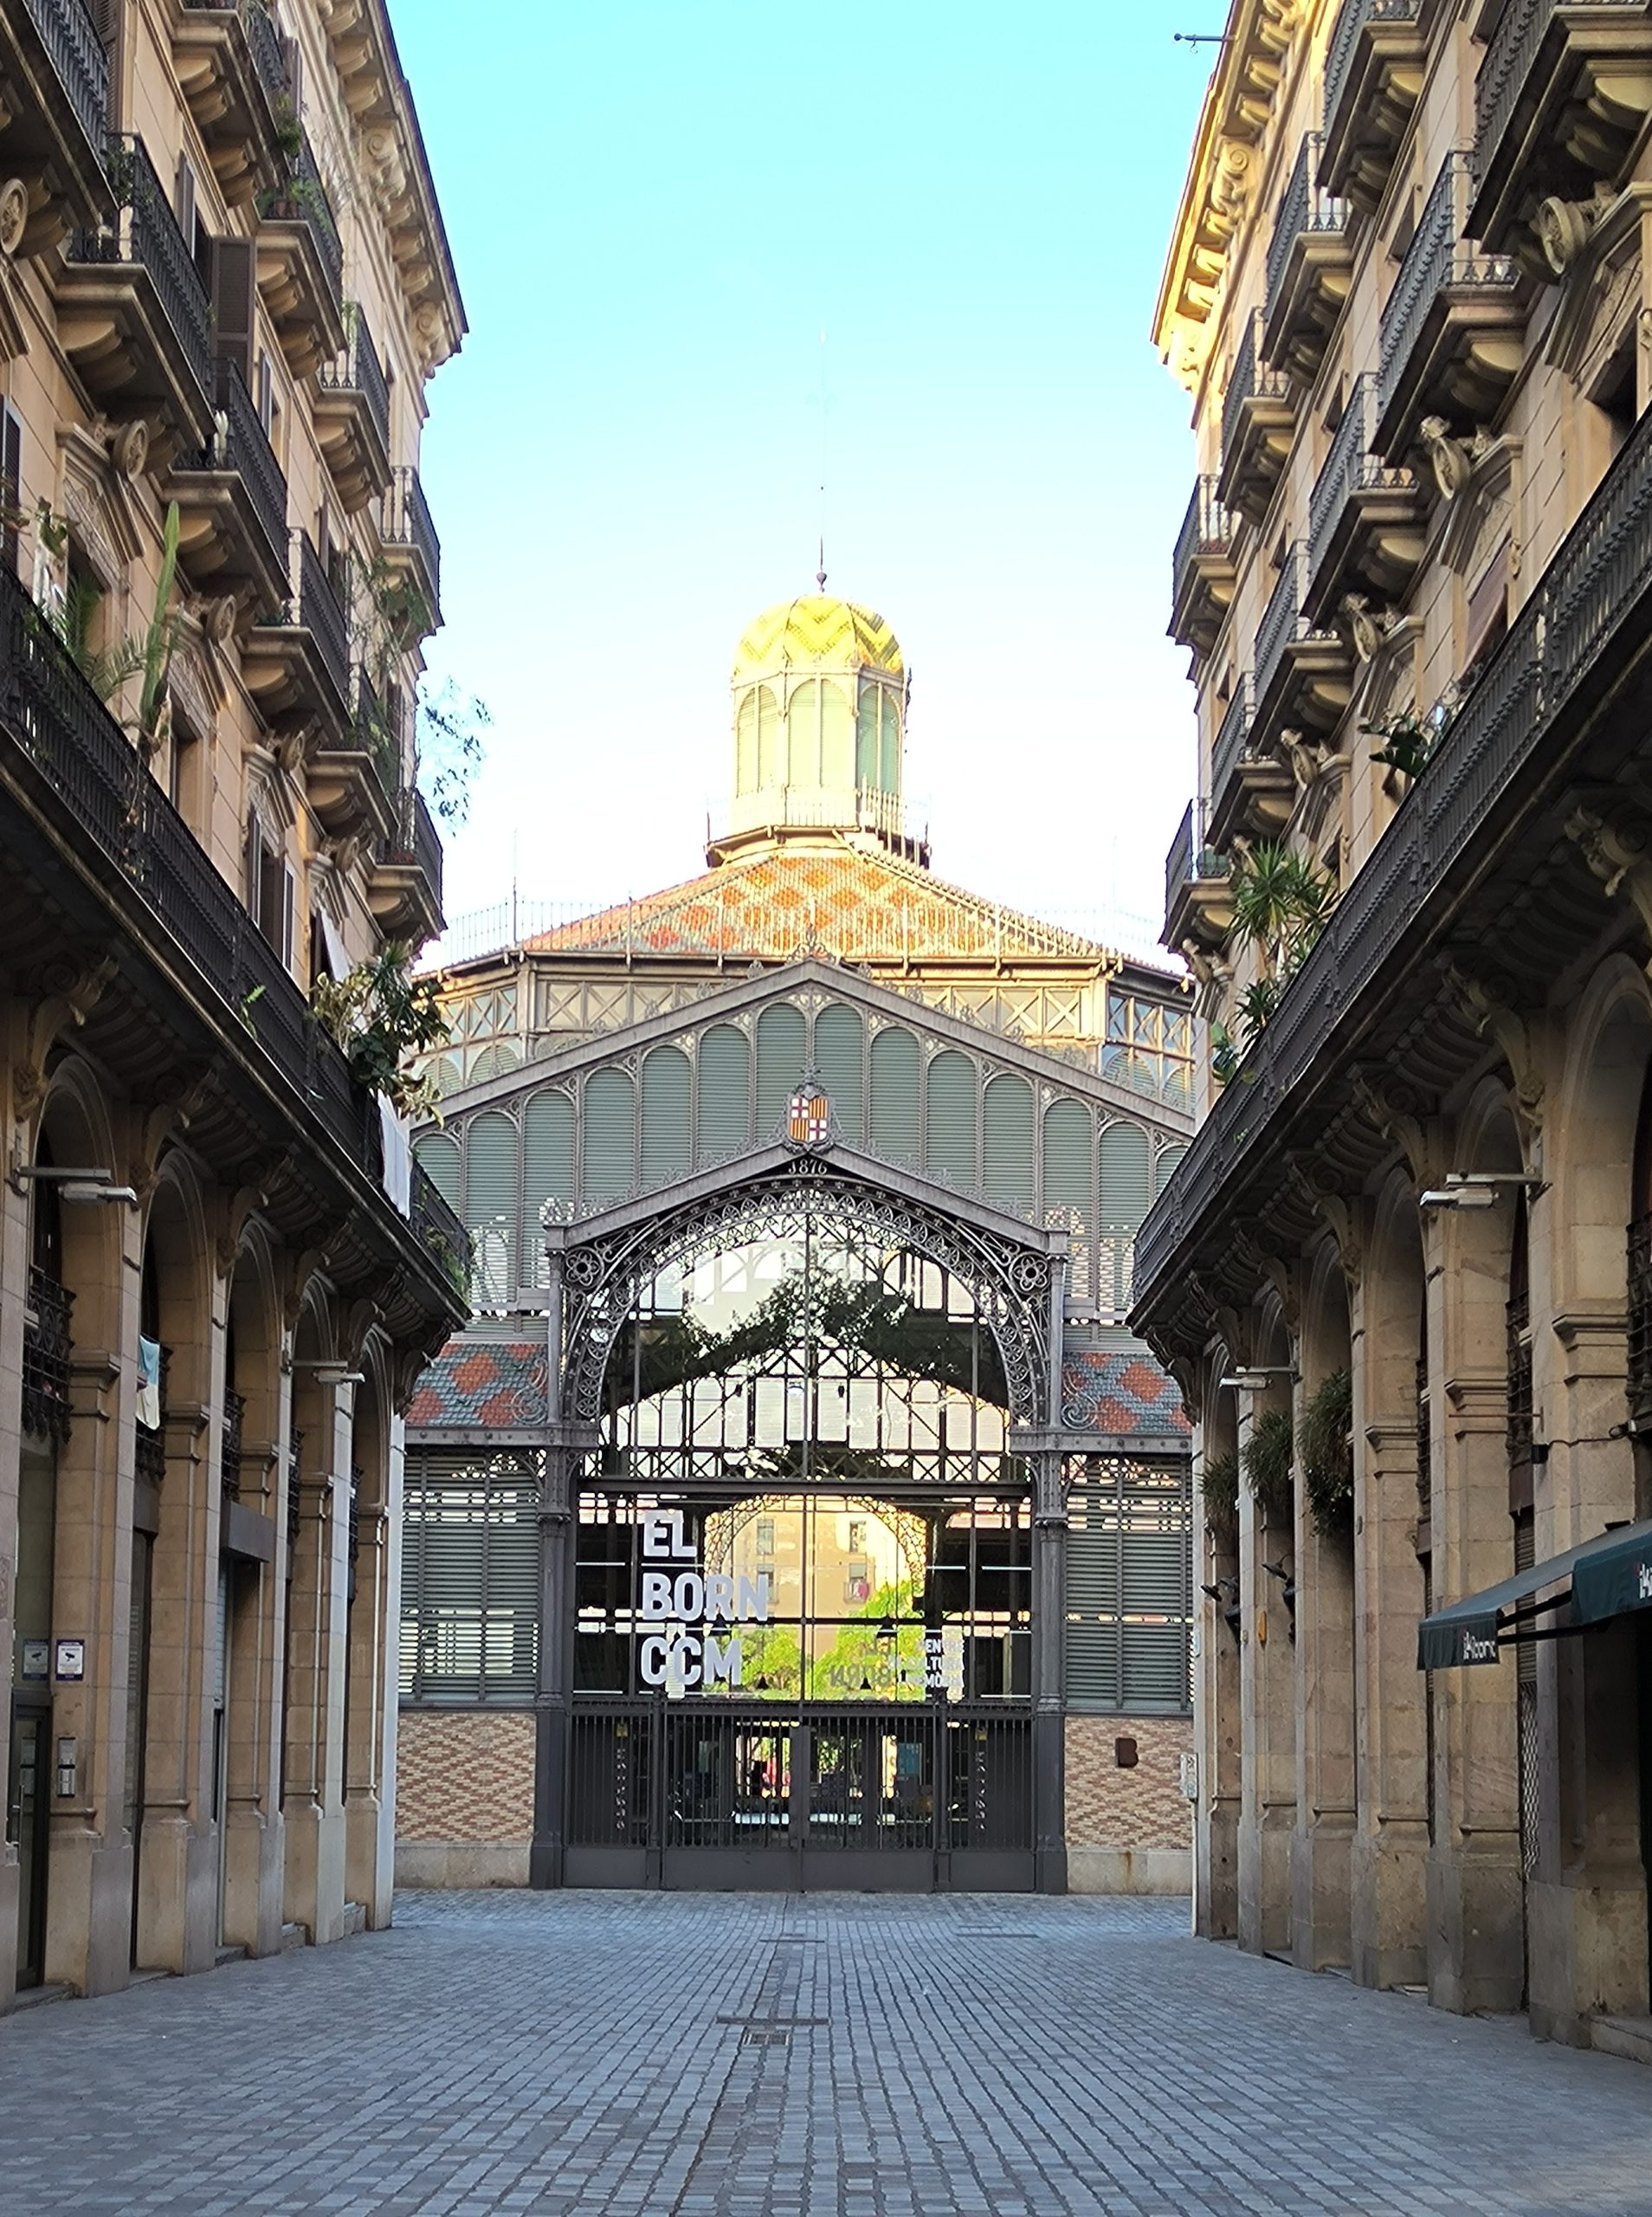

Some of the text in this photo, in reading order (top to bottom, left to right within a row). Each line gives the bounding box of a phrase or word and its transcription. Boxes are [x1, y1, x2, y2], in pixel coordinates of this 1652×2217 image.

[788, 1159, 828, 1175] 1876
[643, 1509, 698, 1557] EL
[642, 1572, 769, 1621] BORN
[641, 1636, 742, 1686] CCM
